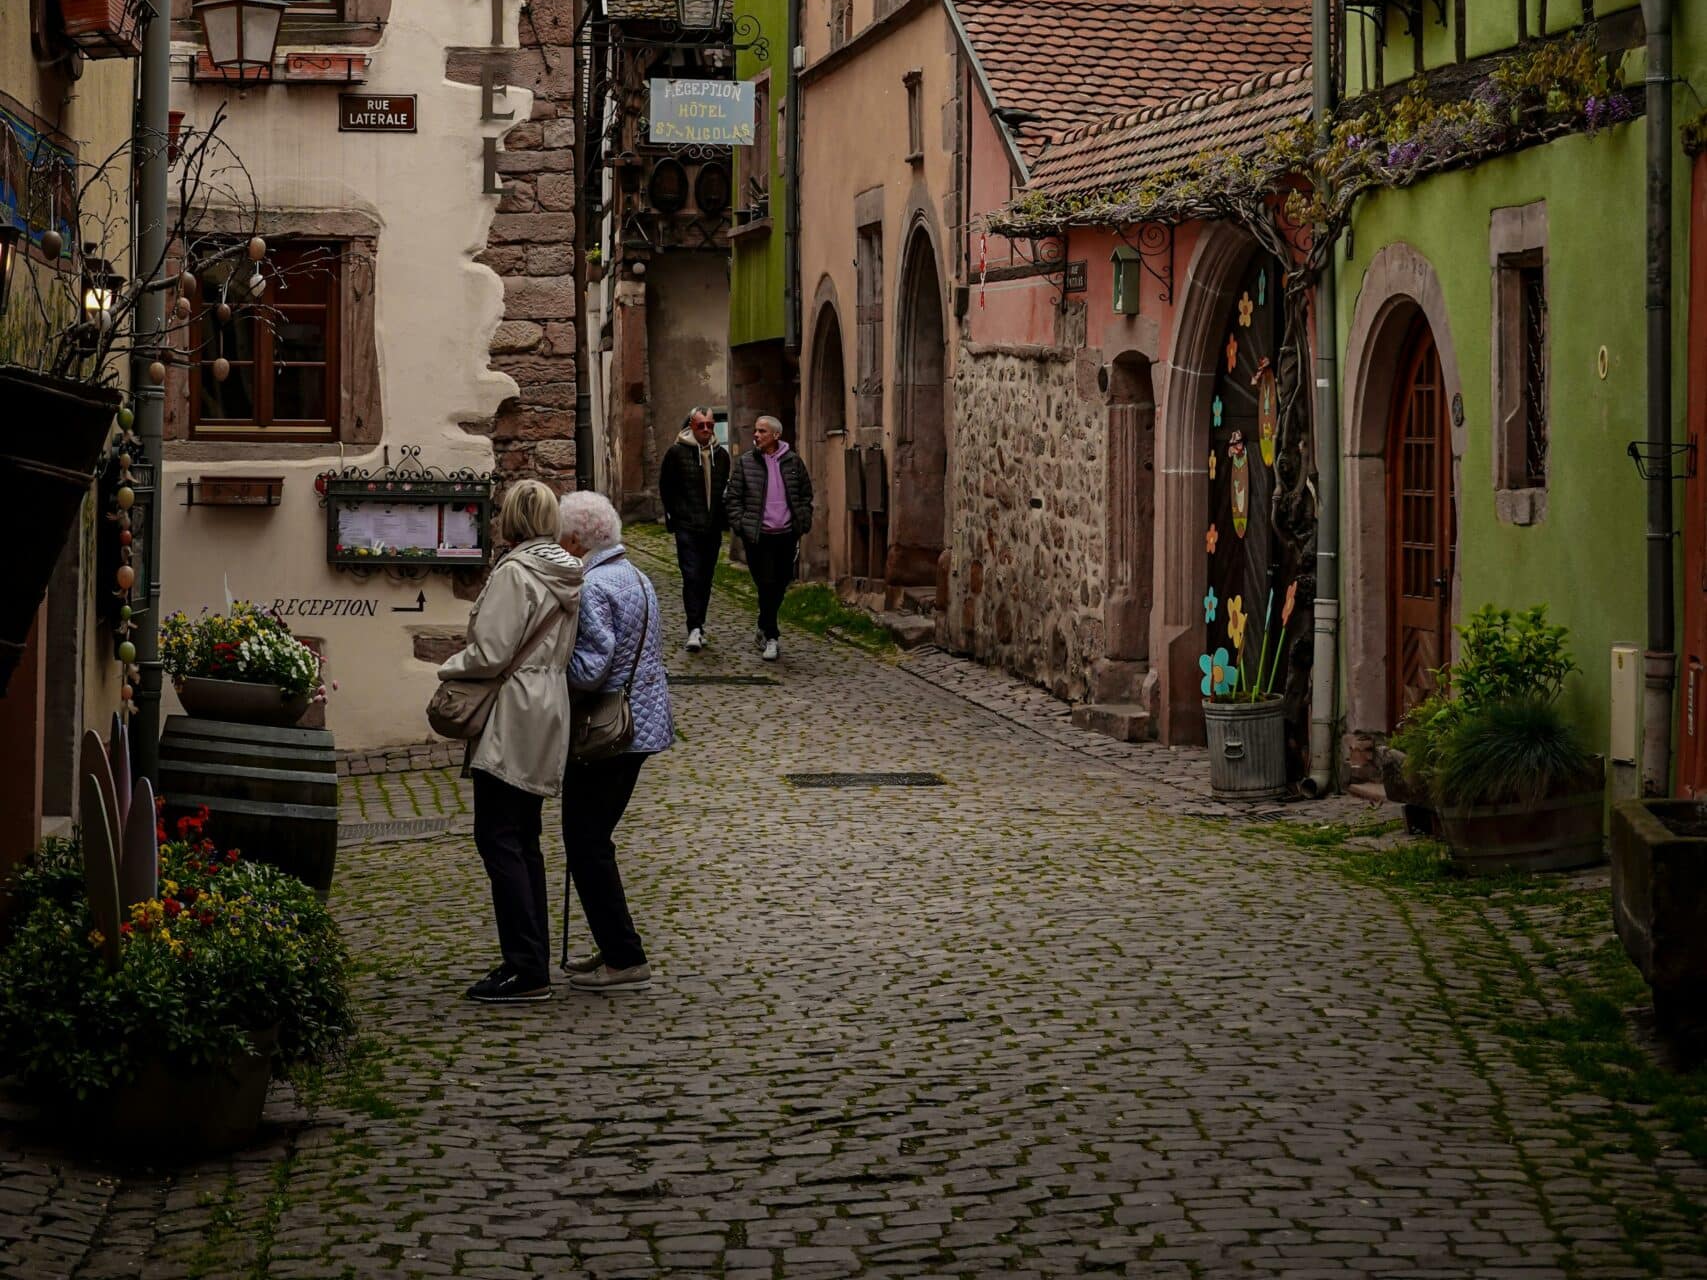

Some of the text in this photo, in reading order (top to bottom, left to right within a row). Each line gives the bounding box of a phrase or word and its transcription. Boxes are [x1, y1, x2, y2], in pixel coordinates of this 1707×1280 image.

[367, 100, 389, 110] RUE
[349, 113, 408, 125] LATERALE
[271, 599, 379, 616] RECEPTION
